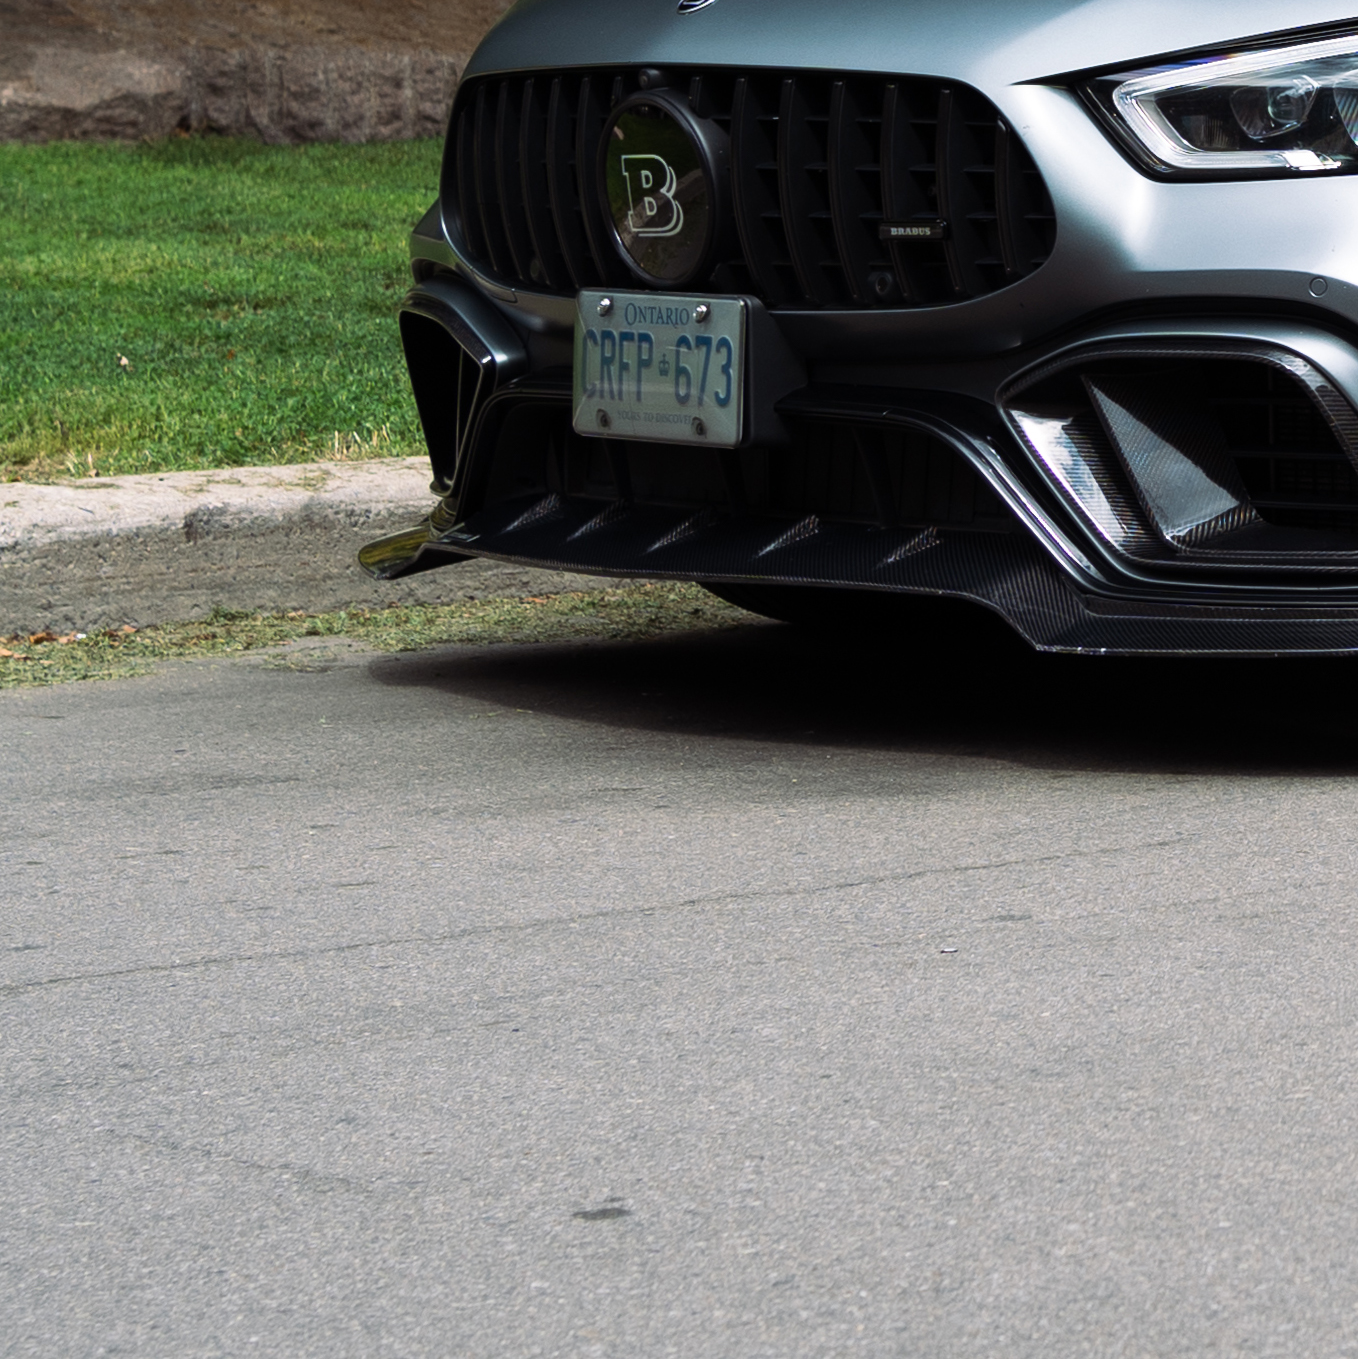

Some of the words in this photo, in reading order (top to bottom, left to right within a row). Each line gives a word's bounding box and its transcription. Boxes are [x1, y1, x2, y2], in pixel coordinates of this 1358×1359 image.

[621, 154, 684, 237] B
[890, 227, 931, 236] BRABUS
[624, 302, 690, 329] ONTARIO
[581, 328, 654, 403] CRFP
[674, 334, 733, 407] 673
[643, 412, 654, 422] TO
